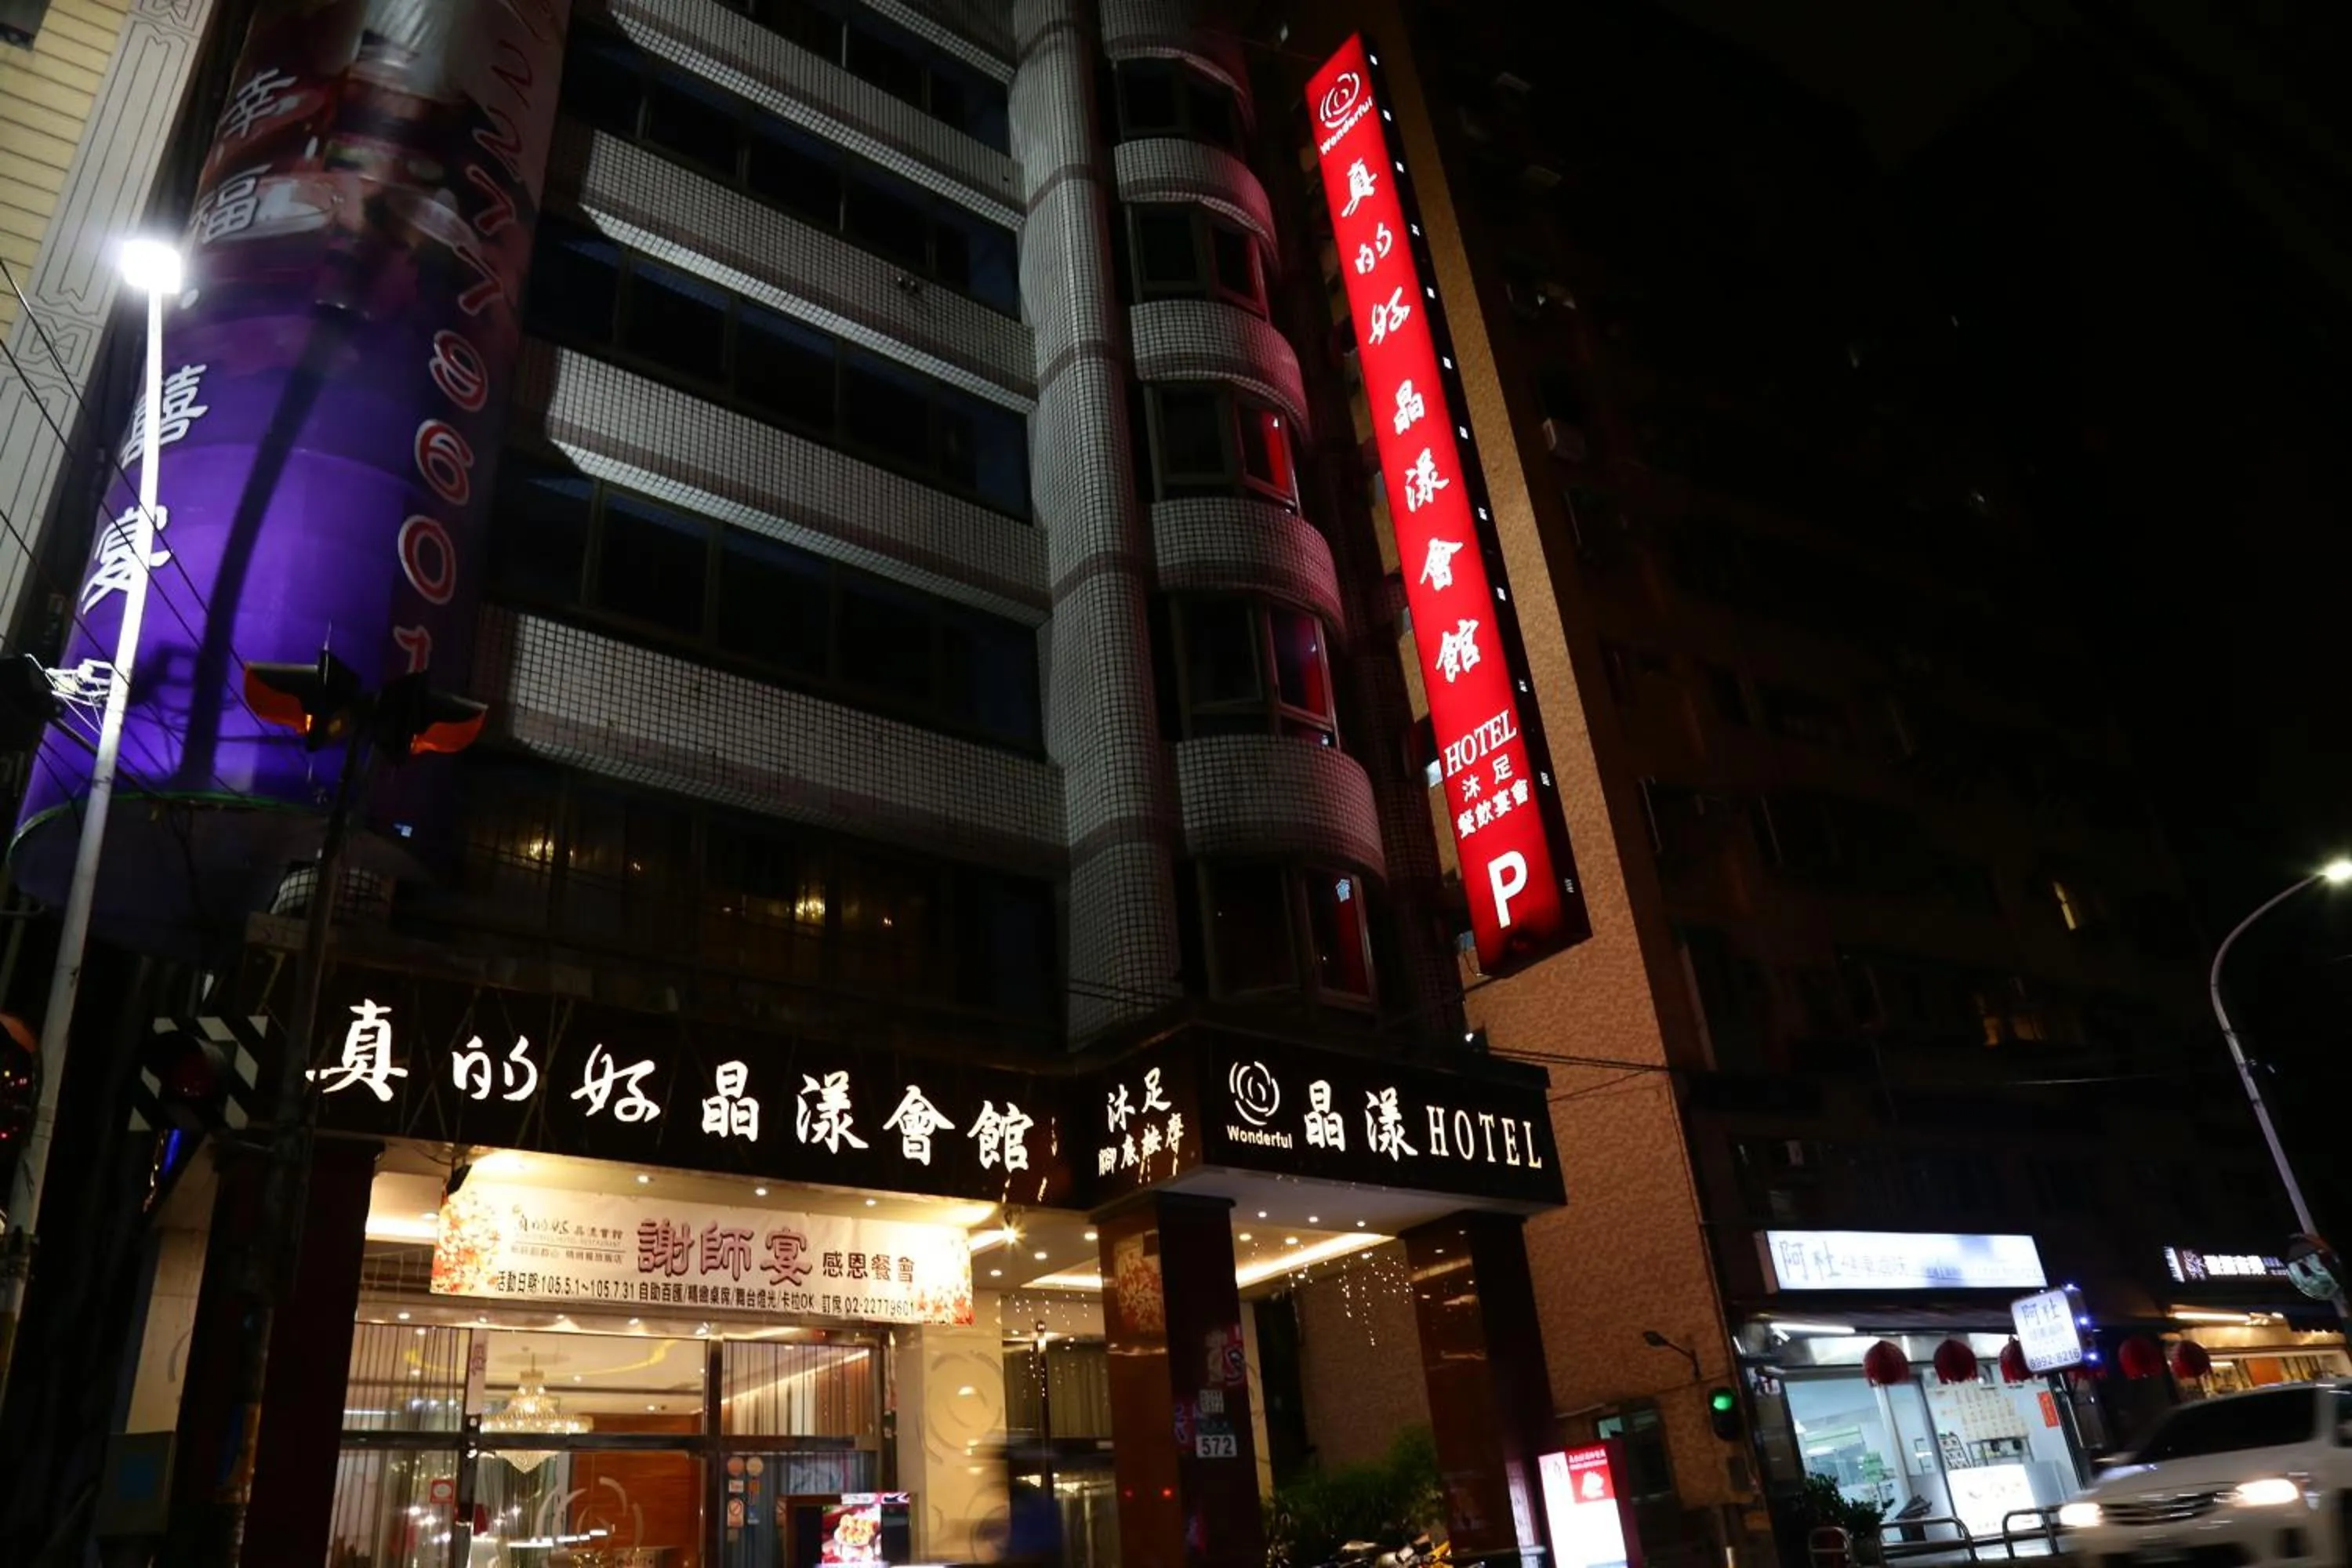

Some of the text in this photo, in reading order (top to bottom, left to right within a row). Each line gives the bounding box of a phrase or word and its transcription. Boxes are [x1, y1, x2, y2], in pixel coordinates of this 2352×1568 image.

[1319, 98, 1374, 156] Wonderful
[1444, 709, 1519, 778] HOTEL
[1457, 777, 1530, 840] 餐飲宴會
[1487, 850, 1528, 929] P
[1106, 1067, 1173, 1134] 沐足
[1226, 1124, 1294, 1149] Wonderful
[1425, 1104, 1543, 1170] HOTEL
[637, 1215, 815, 1287] 謝師宴
[822, 1250, 916, 1283] 感恩餐會
[1200, 1437, 1233, 1456] 572
